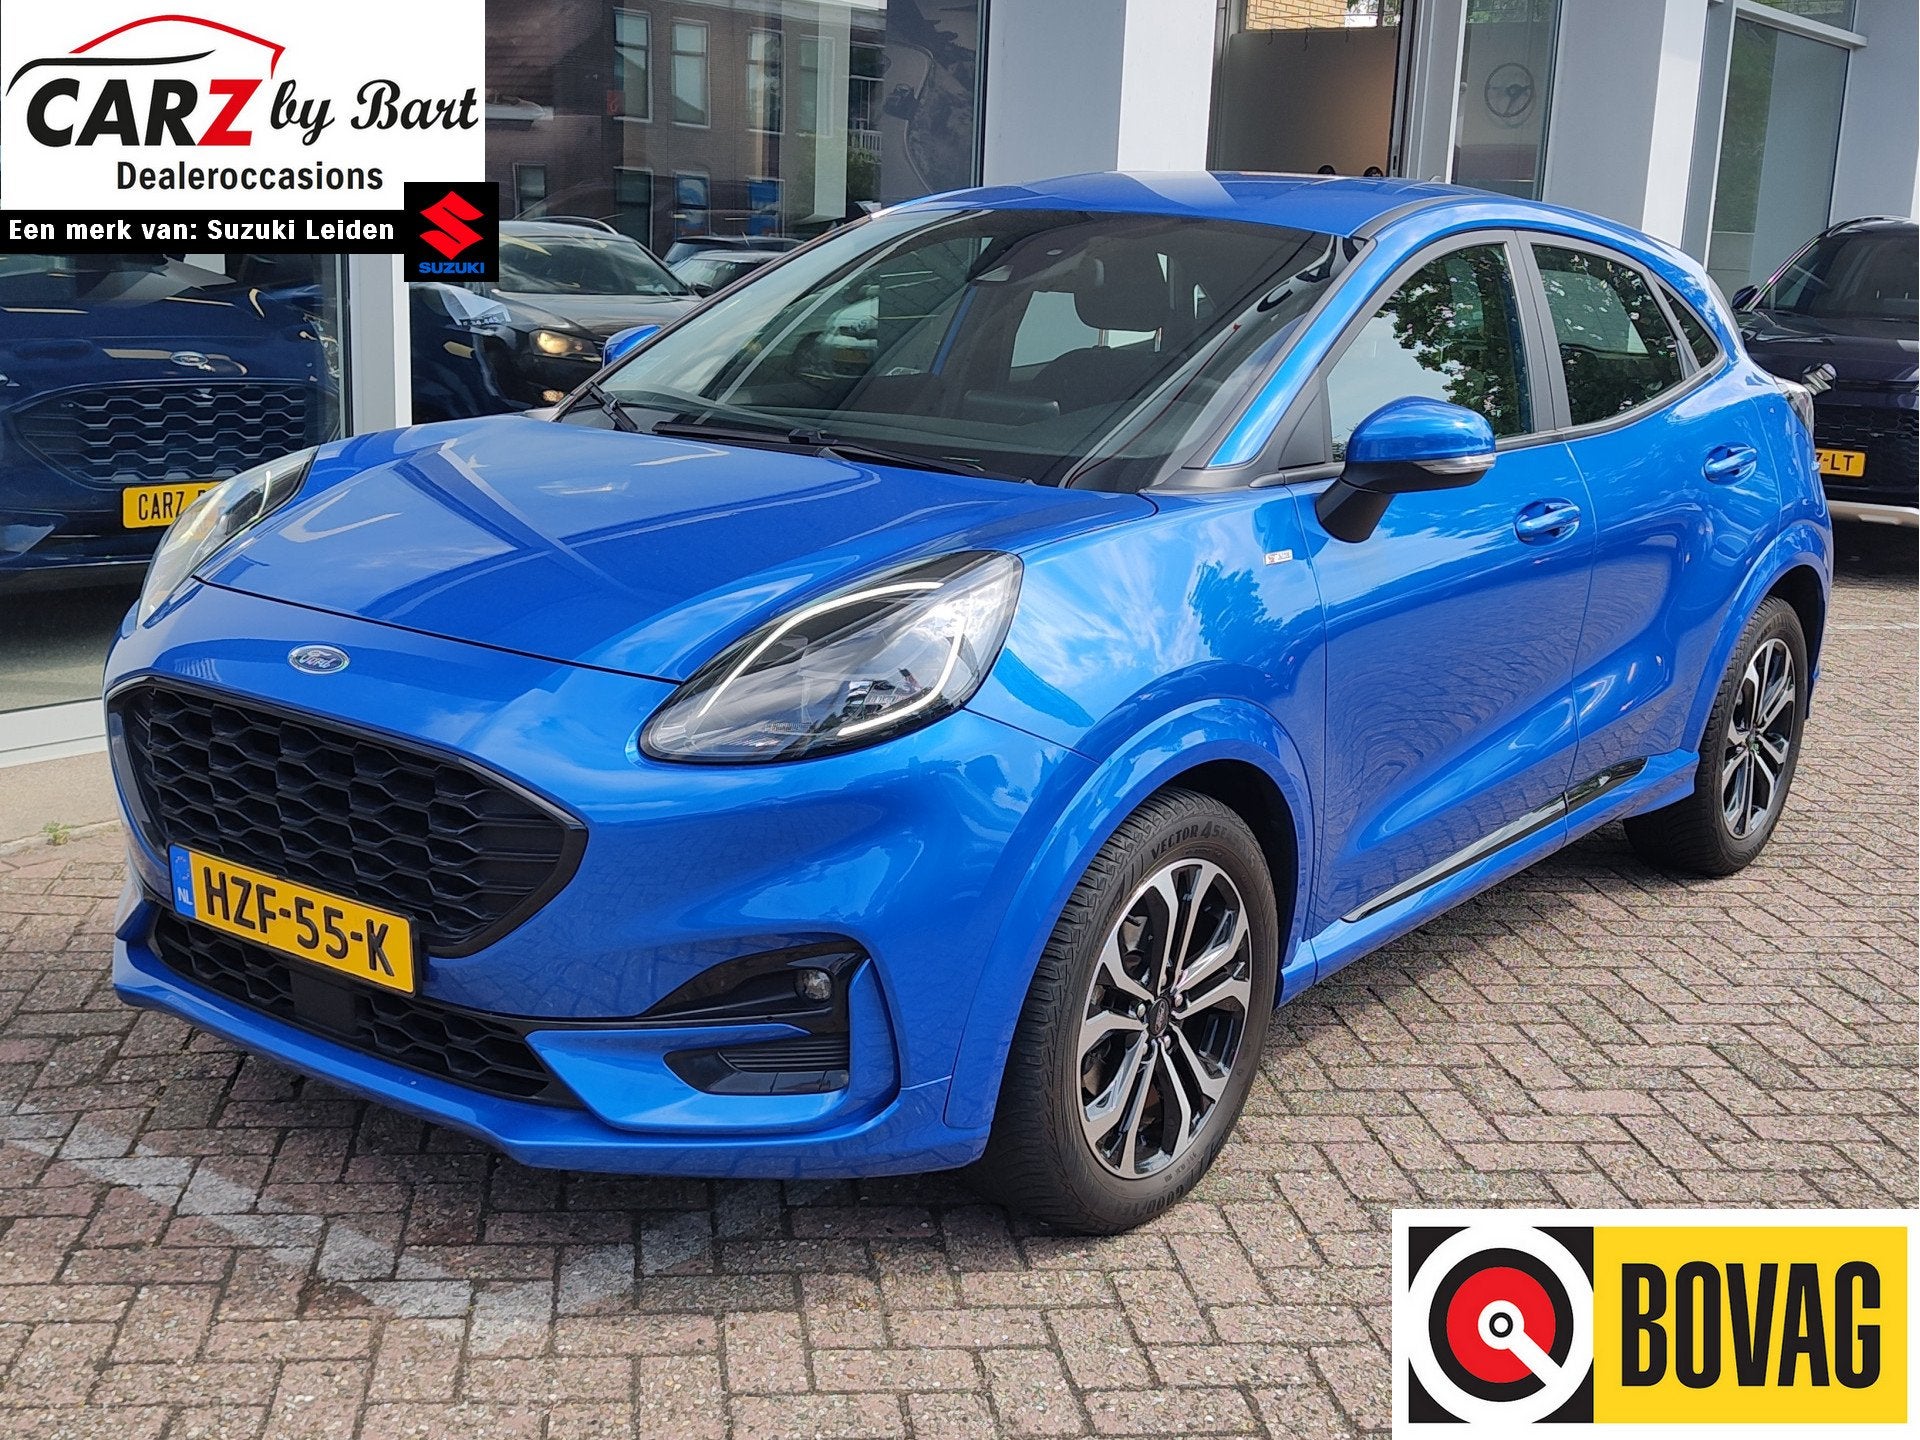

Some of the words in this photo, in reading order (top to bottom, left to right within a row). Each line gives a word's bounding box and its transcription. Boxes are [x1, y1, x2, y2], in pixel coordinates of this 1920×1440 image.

[138, 491, 185, 521] CARZ
[1151, 824, 1199, 860] VECTOR
[177, 886, 194, 906] NL
[203, 866, 395, 977] HZF-55-K
